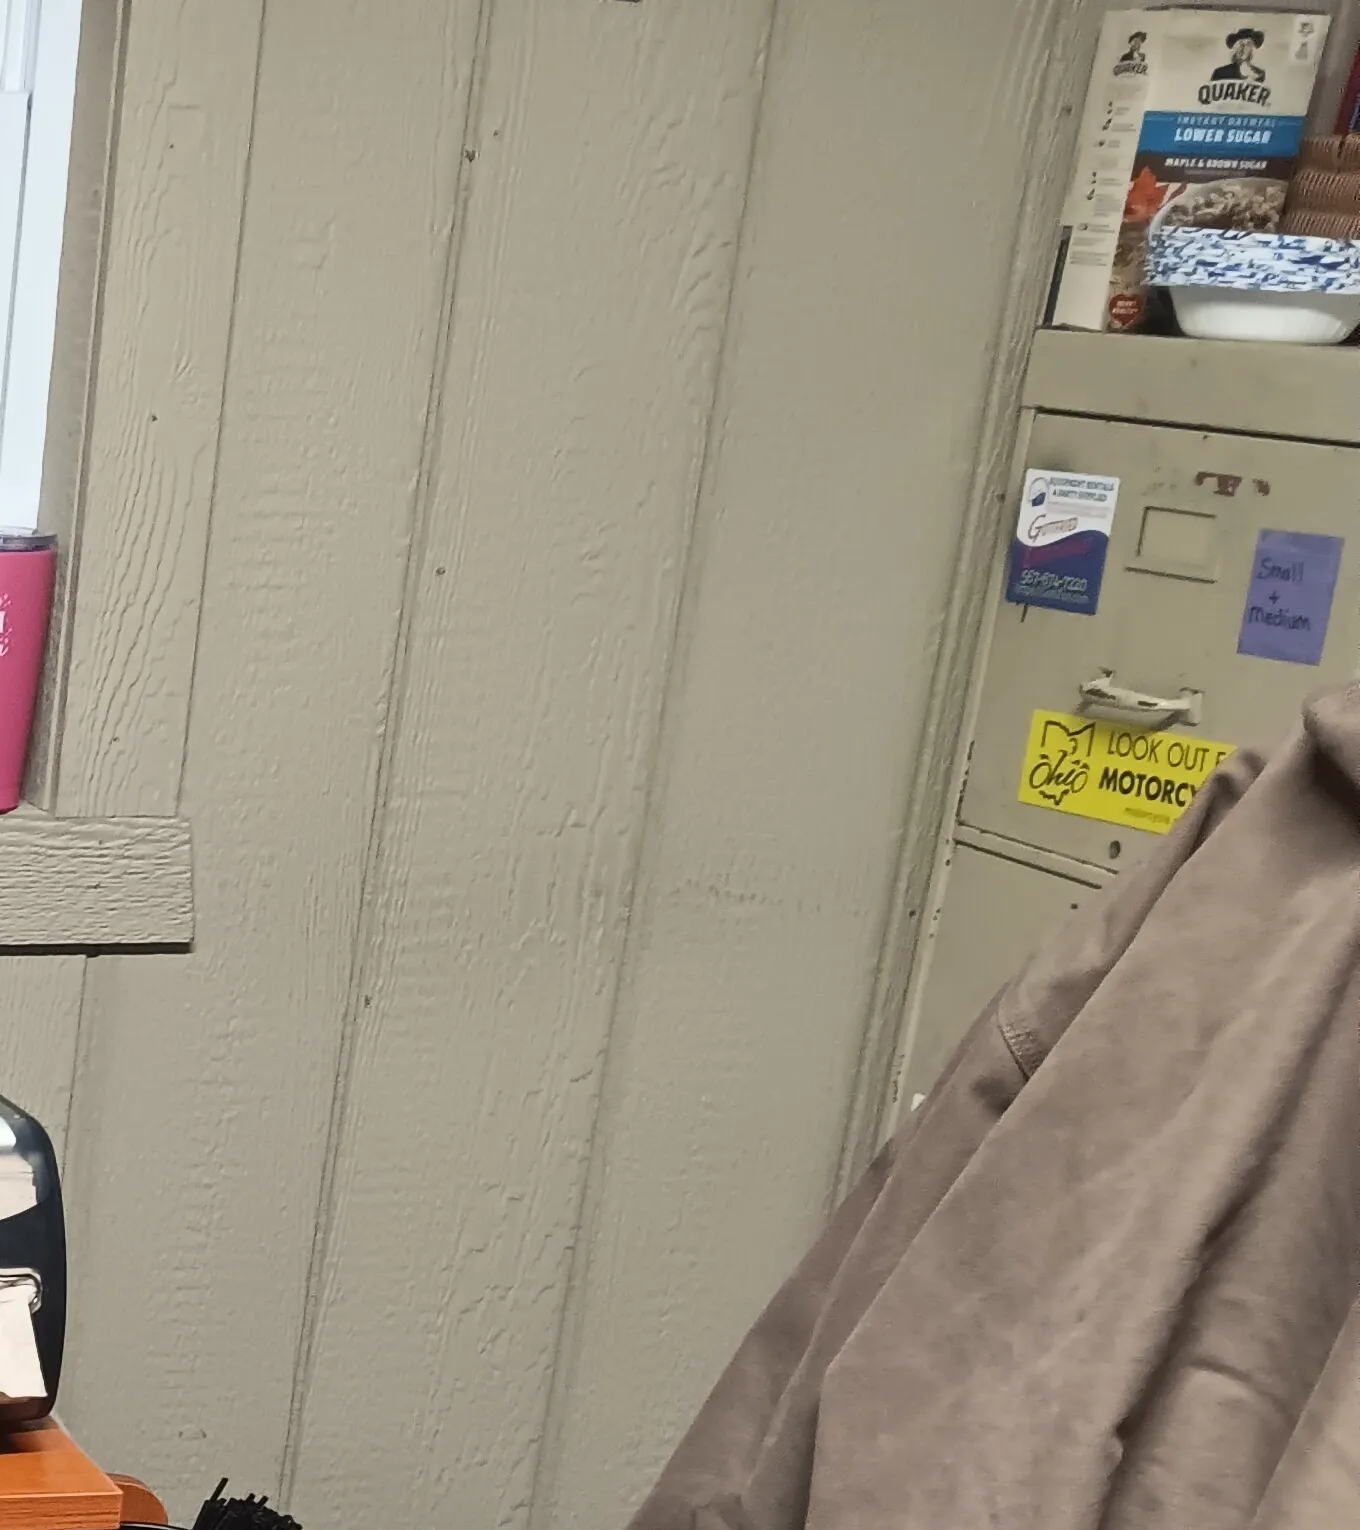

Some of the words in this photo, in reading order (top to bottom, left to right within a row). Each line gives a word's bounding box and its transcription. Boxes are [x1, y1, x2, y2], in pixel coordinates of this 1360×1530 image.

[1198, 82, 1272, 107] QUAKER
[1174, 127, 1224, 143] LOWER
[1226, 128, 1272, 144] SUGAR
[1256, 557, 1304, 583] Small
[1108, 730, 1163, 763] LOOK
[1167, 742, 1210, 772] OUT
